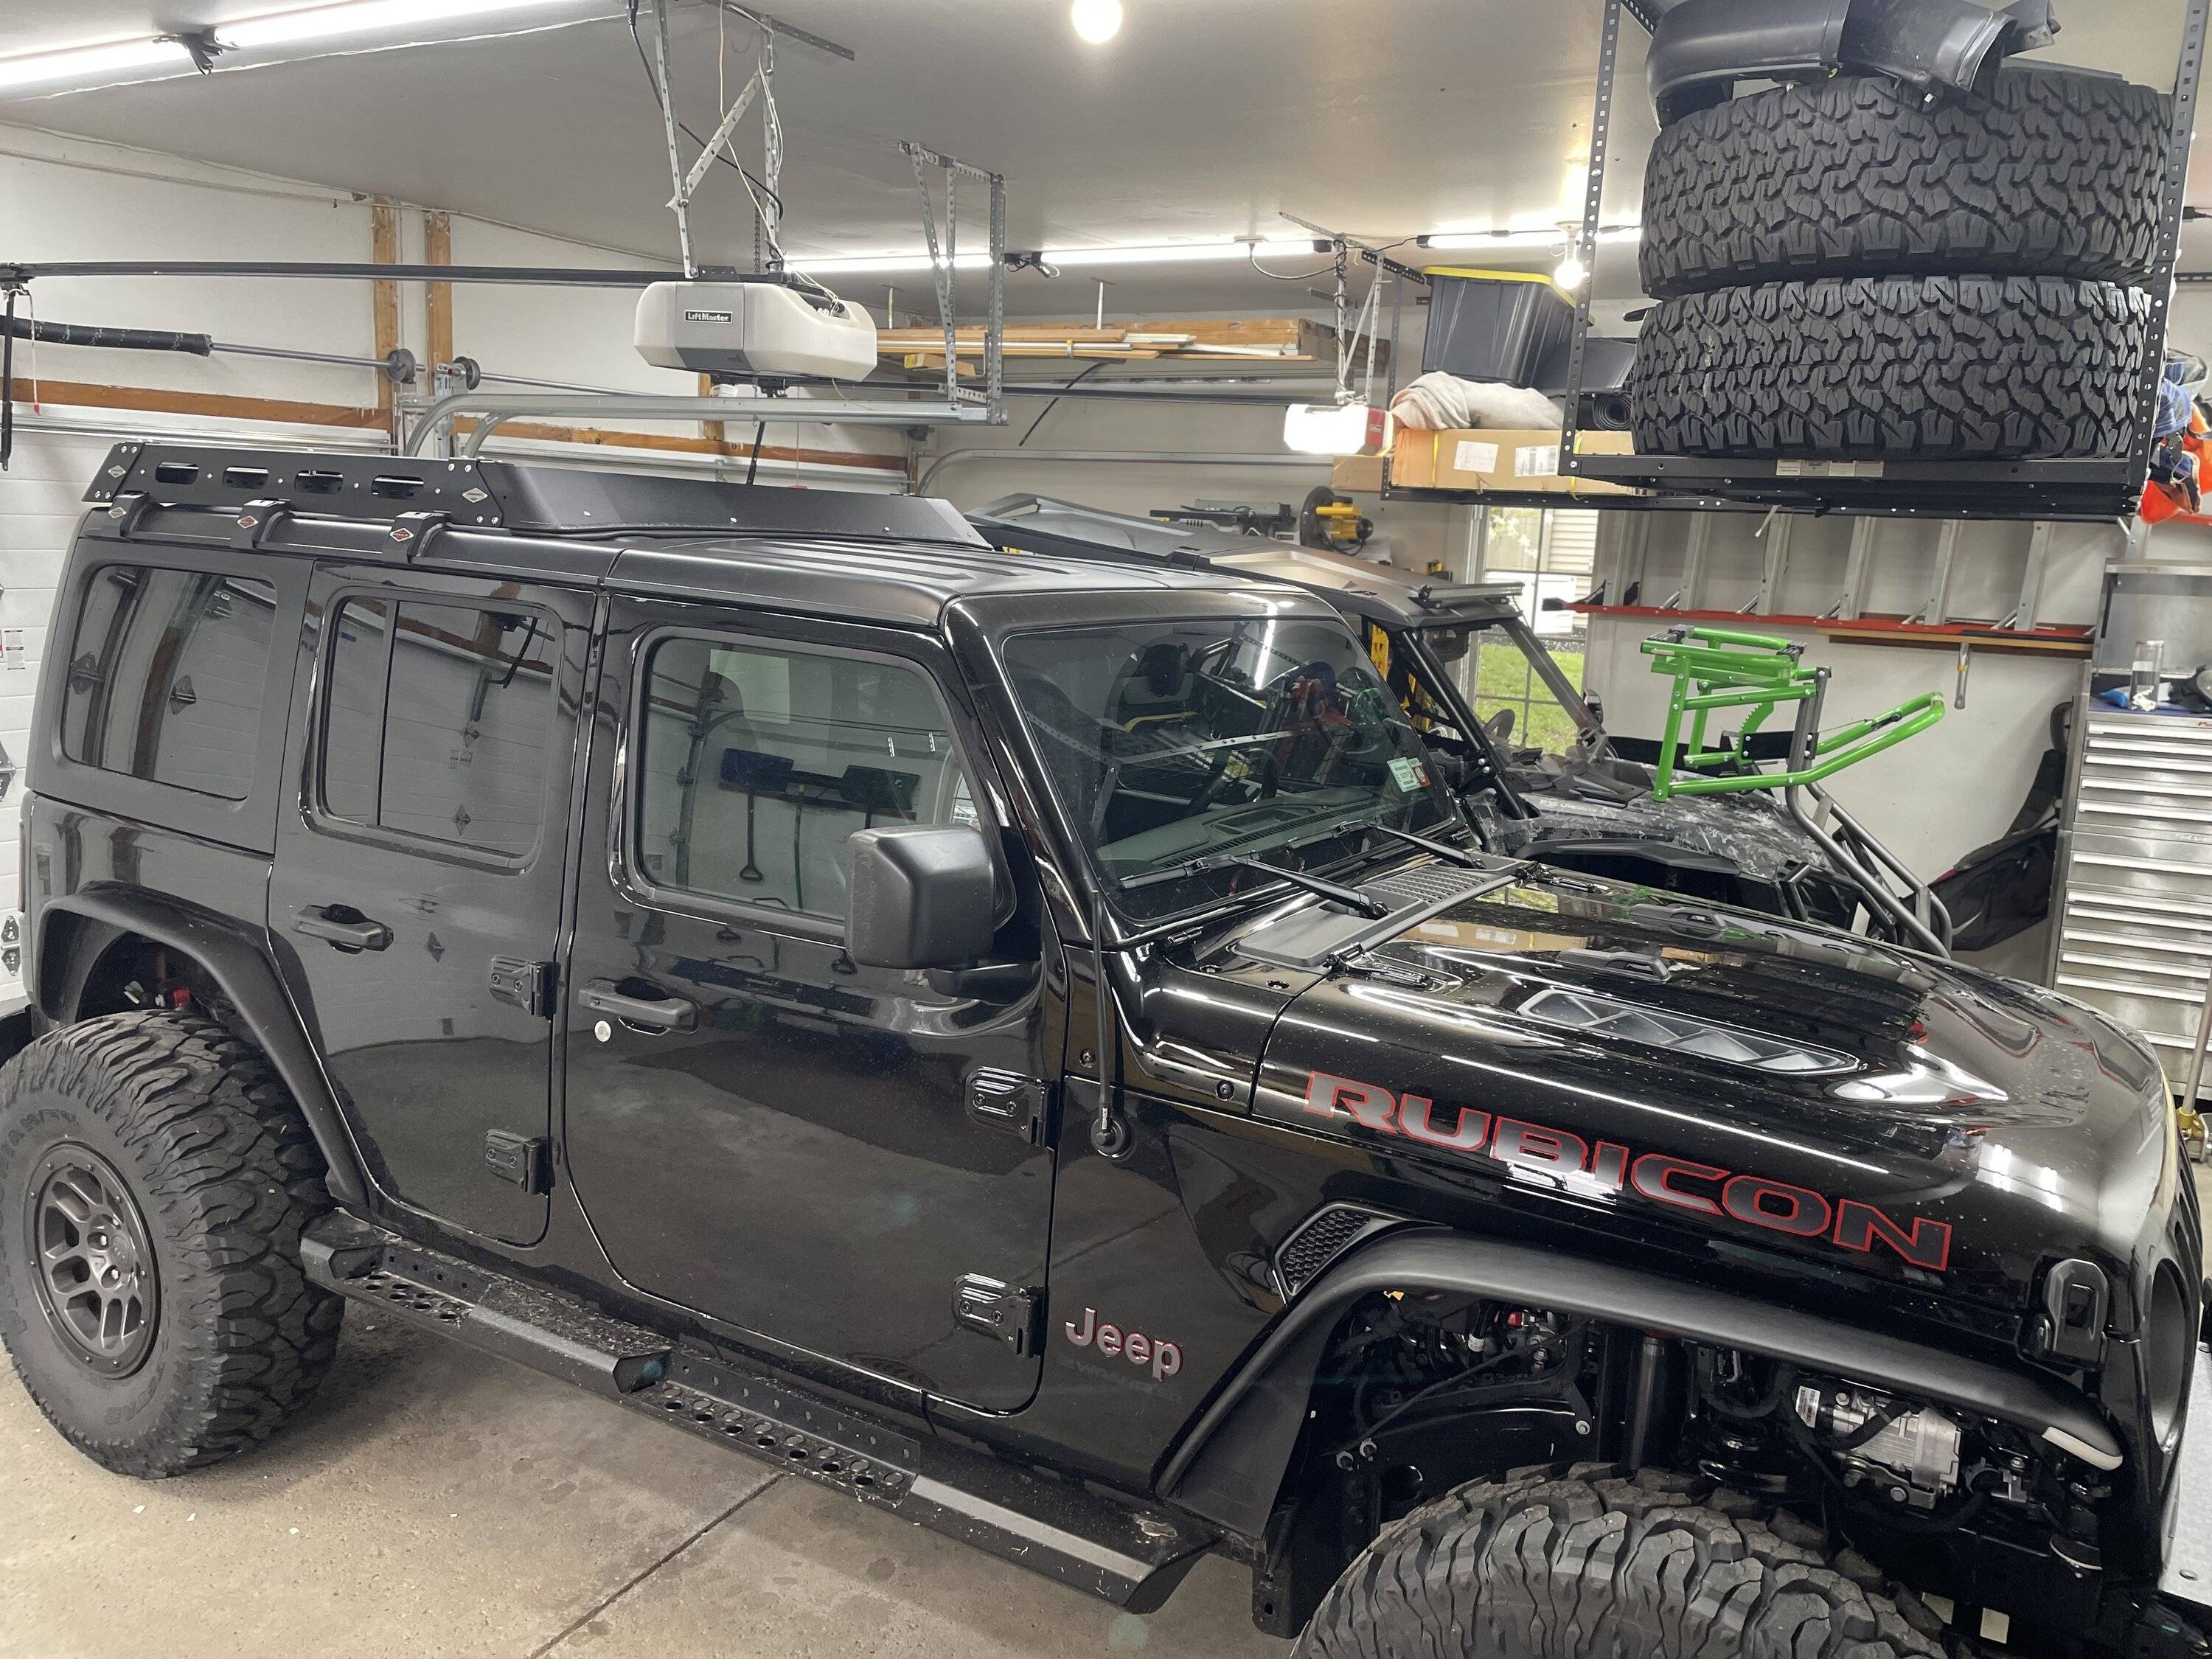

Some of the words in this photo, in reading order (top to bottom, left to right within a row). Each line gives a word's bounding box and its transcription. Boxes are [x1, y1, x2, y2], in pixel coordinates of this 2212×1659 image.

[687, 312, 729, 321] LiftMaster
[1304, 1069, 1953, 1271] RUBICON
[1065, 1306, 1184, 1382] Jeep
